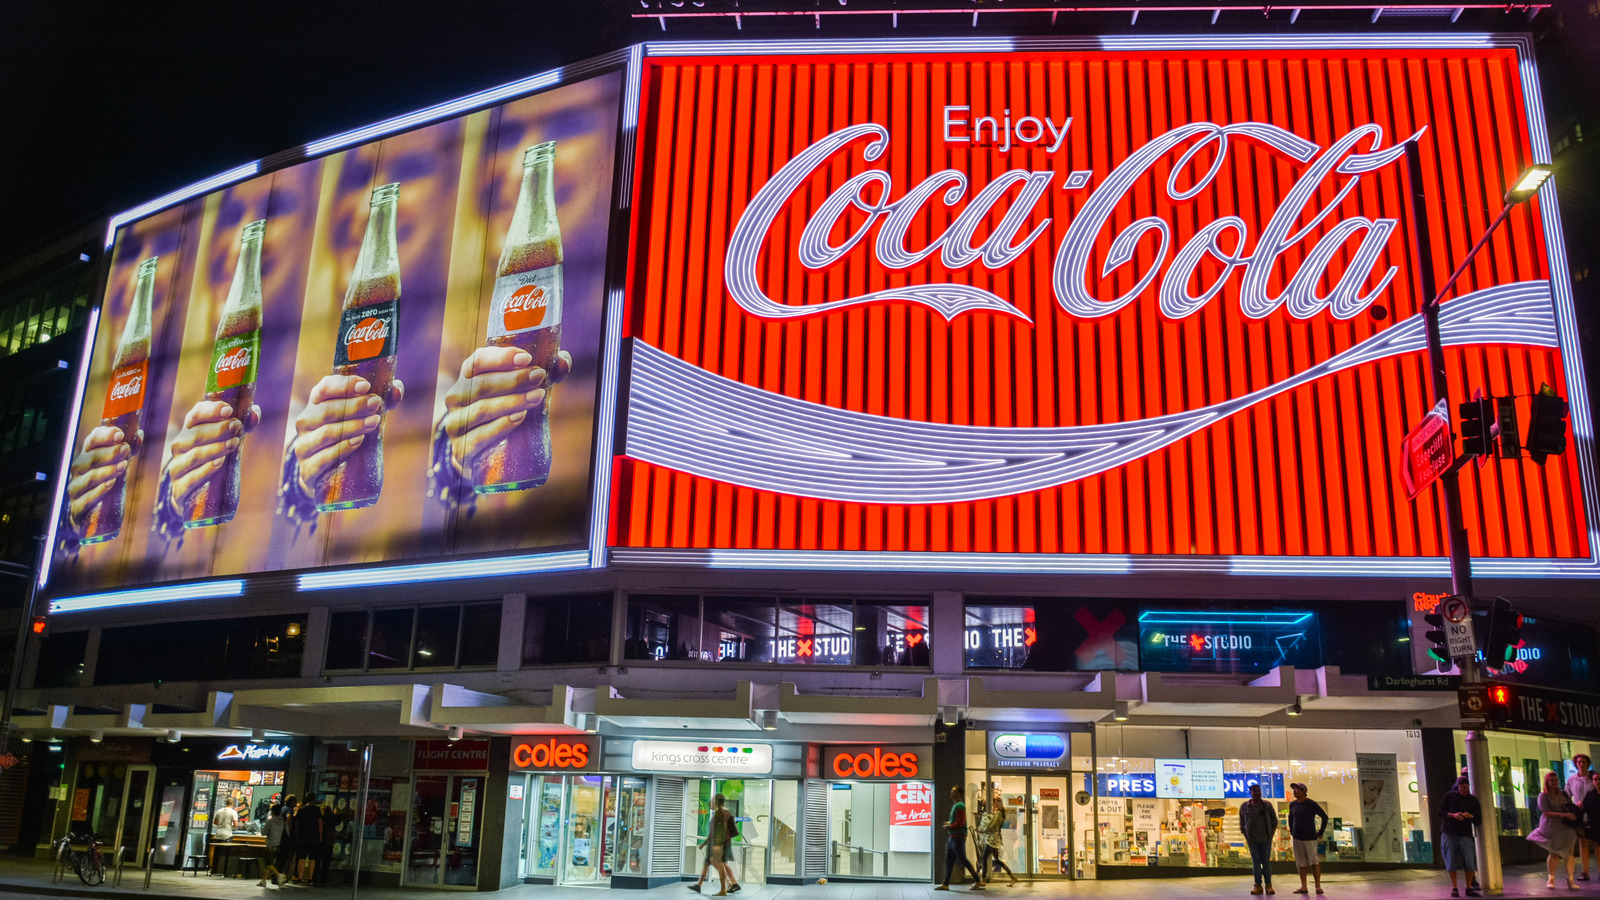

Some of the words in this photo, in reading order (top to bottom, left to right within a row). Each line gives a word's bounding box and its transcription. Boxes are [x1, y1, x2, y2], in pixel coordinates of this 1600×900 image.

[944, 105, 1073, 153] Enjoy
[518, 274, 537, 286] Diet
[361, 308, 378, 318] zero
[1416, 431, 1444, 467] Edgecliff
[1418, 453, 1446, 484] Vaucluse
[1413, 591, 1450, 603] Clau
[1451, 625, 1467, 636] NO
[992, 628, 1023, 648] THE
[1205, 635, 1252, 650] STUDIO
[1450, 636, 1472, 645] RIGHT
[770, 640, 796, 658] THE
[815, 637, 850, 656] STUD
[1451, 645, 1473, 653] TURN
[1386, 676, 1433, 688] Darlinghurst
[1434, 676, 1449, 686] Rd
[1518, 695, 1545, 722] THE
[1405, 730, 1421, 738] TG13
[242, 744, 268, 760] Pizza
[268, 744, 290, 758] Hut
[417, 750, 449, 760] FLIGHT
[450, 750, 488, 760] CENTRE
[513, 739, 589, 768] coles
[651, 751, 682, 766] kings
[683, 754, 710, 763] cross
[711, 755, 749, 765] centre
[833, 747, 919, 777] coles
[1357, 757, 1391, 767] Fillerina
[1107, 779, 1155, 792] PRES
[1195, 784, 1216, 792] $32.49
[894, 810, 907, 821] The
